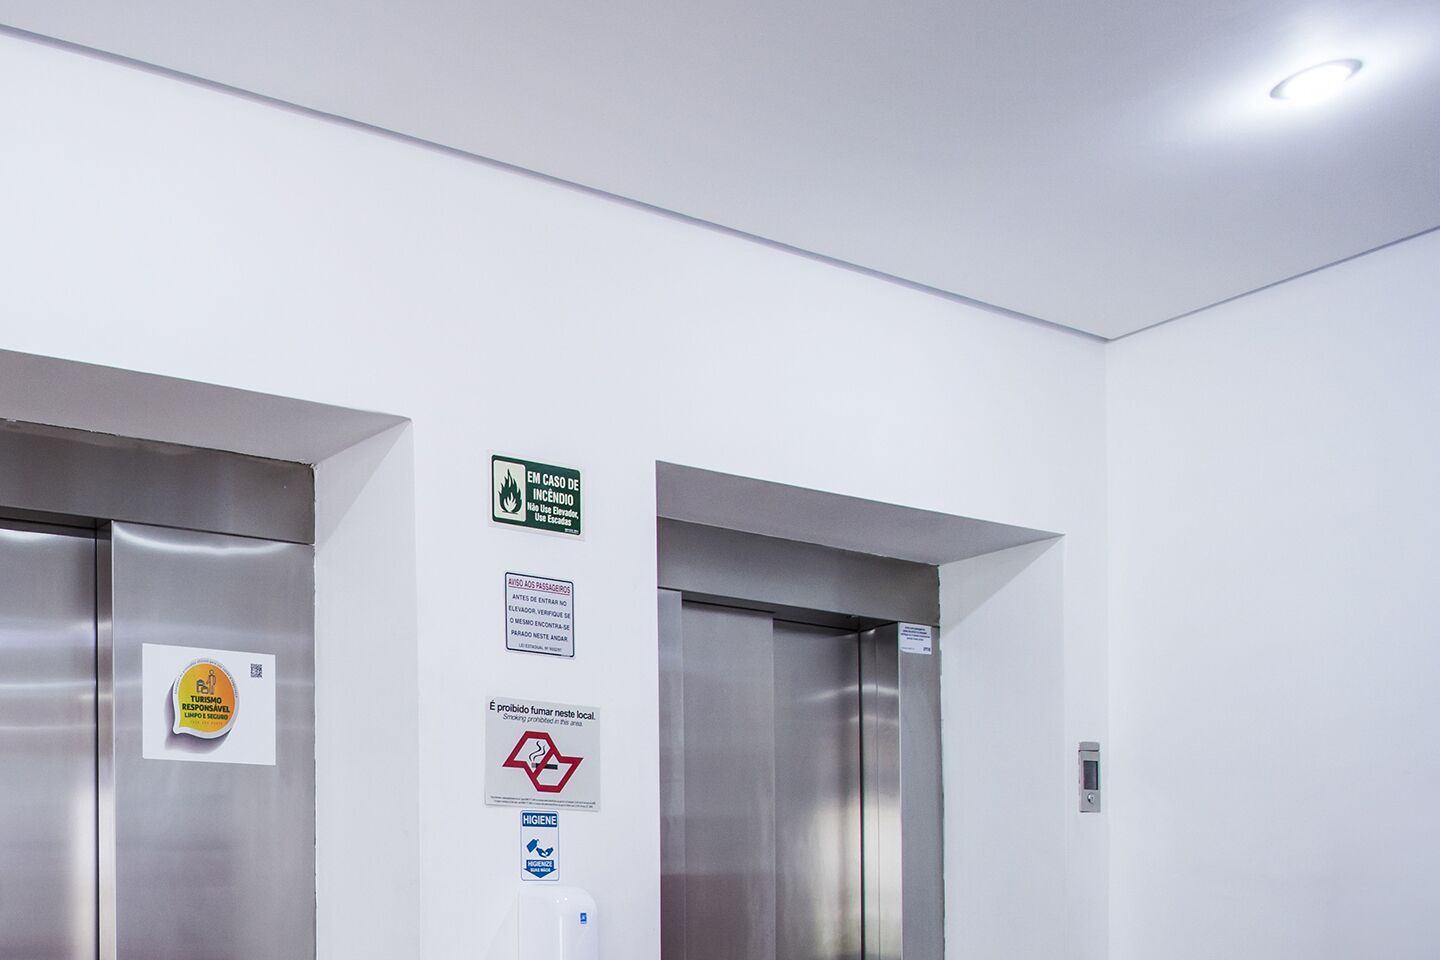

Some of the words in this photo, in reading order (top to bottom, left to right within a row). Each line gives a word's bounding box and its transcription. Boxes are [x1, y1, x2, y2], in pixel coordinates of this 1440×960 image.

[527, 470, 540, 484] EM
[543, 473, 566, 488] CASO
[568, 478, 579, 491] DE
[533, 488, 574, 506] INCÊNDIO
[527, 502, 539, 511] Não
[540, 505, 552, 514] Use
[553, 506, 579, 519] Elevador,
[534, 513, 547, 522] Use
[547, 514, 572, 526] Escadas
[508, 578, 523, 587] AVISO
[524, 580, 535, 589] AOS
[536, 581, 571, 594] PASSAGEIROS
[512, 594, 529, 602] ANTES
[538, 597, 558, 605] ENTRAR
[537, 609, 563, 618] VERIFIQUE
[515, 618, 534, 626] MESMO
[535, 621, 570, 631] ENCONTRA-SE
[511, 629, 532, 638] PARADO
[533, 632, 549, 640] NESTE
[190, 695, 222, 704] TURISMO
[182, 702, 230, 713] RESPONSÁVEL
[489, 700, 495, 710] É
[497, 703, 529, 714] proibido
[530, 706, 553, 716] fumar
[554, 709, 575, 717] neste
[576, 710, 596, 720] local.
[503, 713, 527, 723] Smoking
[527, 715, 554, 725] prohibited
[560, 718, 569, 726] this
[523, 815, 557, 825] HIGIENE
